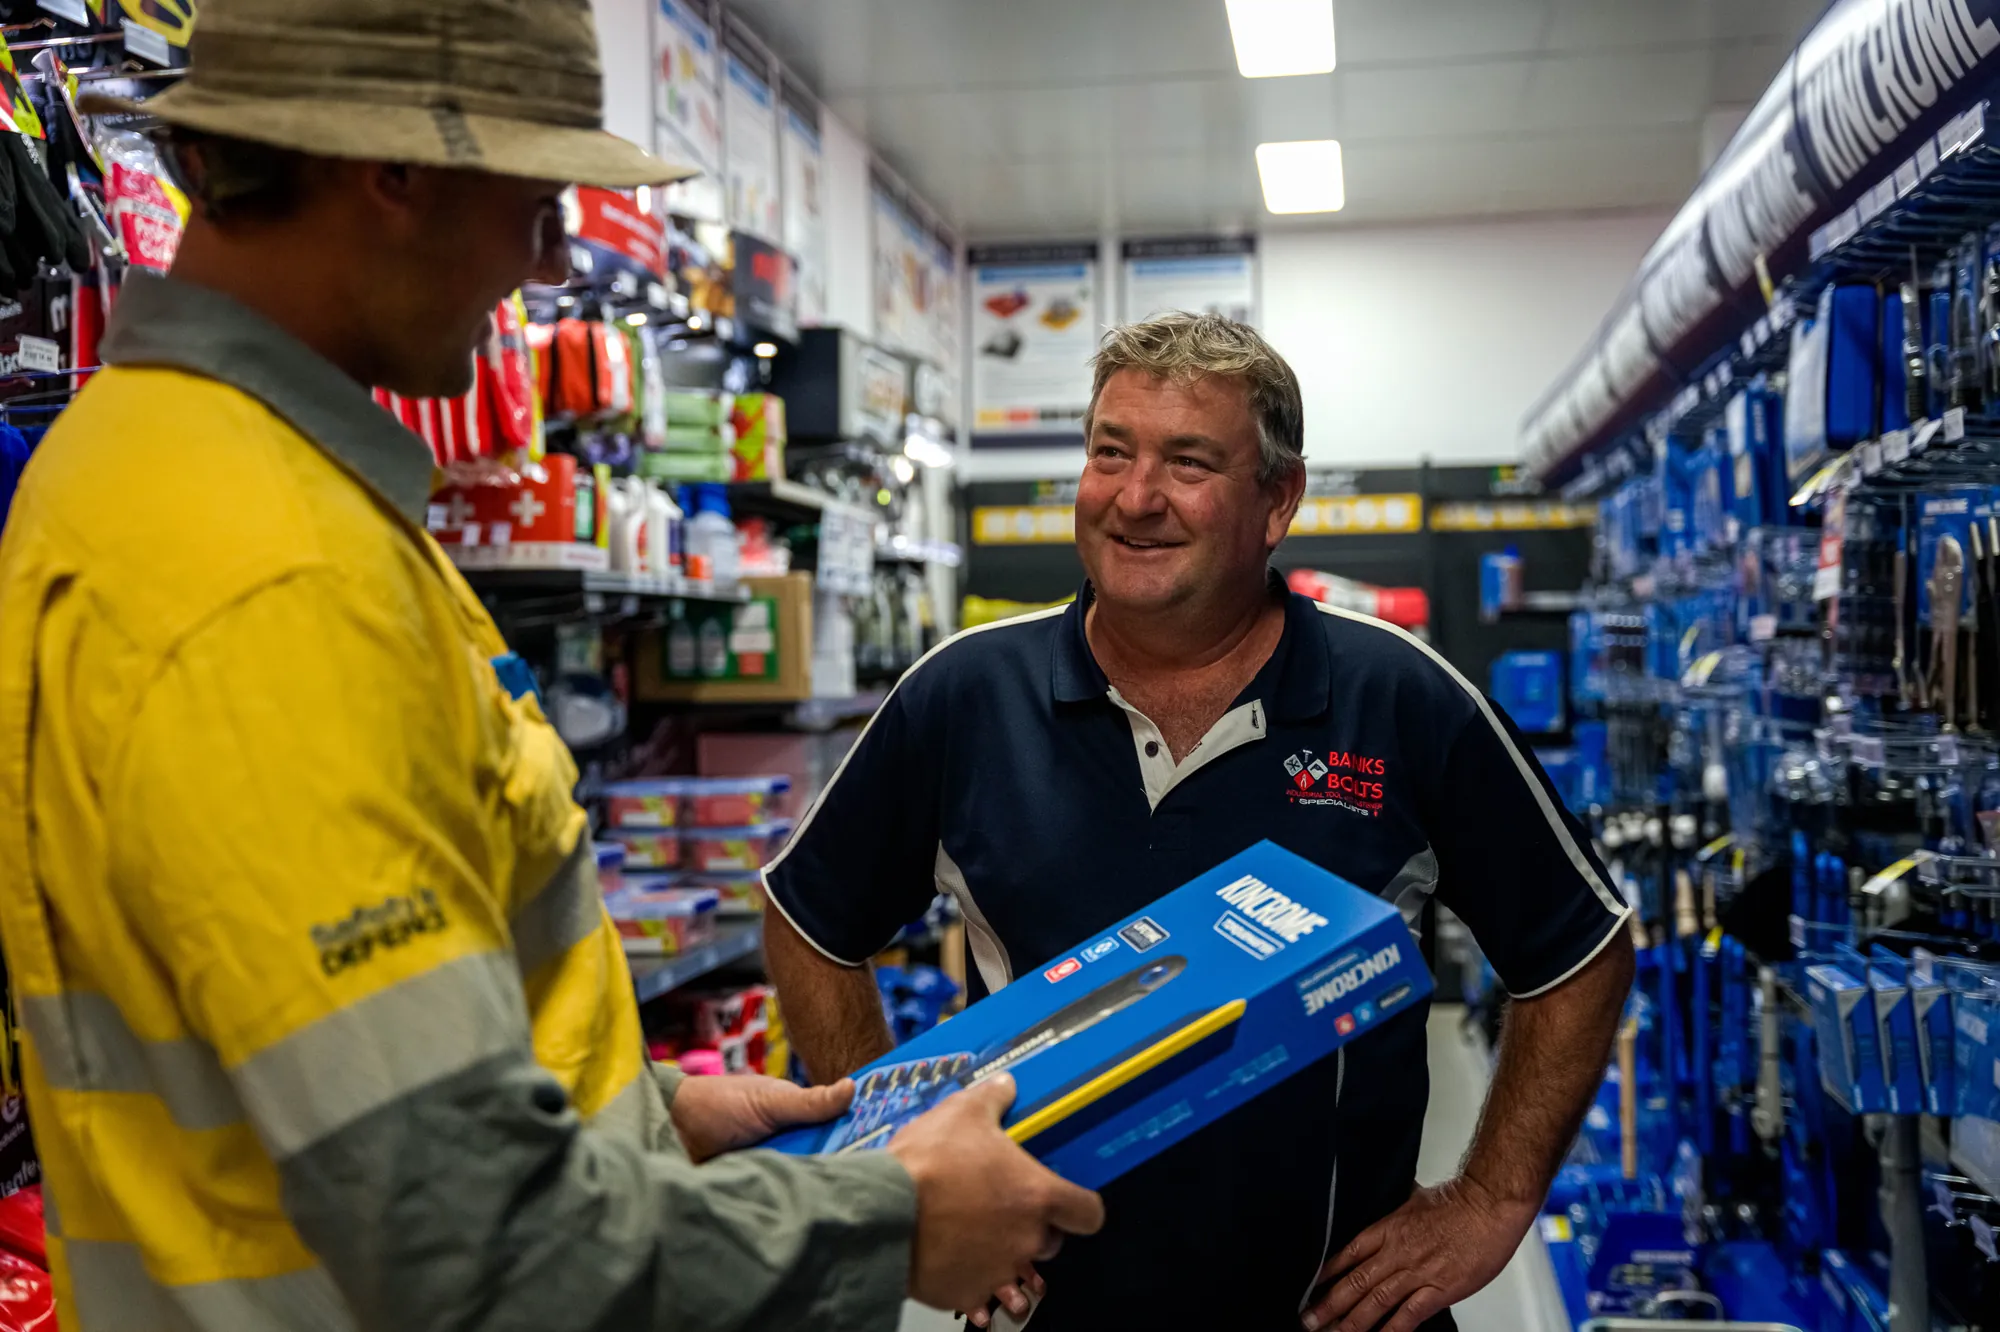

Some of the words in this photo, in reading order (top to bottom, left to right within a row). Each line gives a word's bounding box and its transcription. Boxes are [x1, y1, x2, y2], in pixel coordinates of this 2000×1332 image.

[1329, 751, 1385, 775] BANKS
[1324, 791, 1343, 799] TOOL
[1327, 773, 1383, 799] BOLTS
[1299, 798, 1369, 816] SPECIALISTS
[1216, 874, 1329, 943] KINCROME
[1302, 943, 1401, 1016] KINCROME
